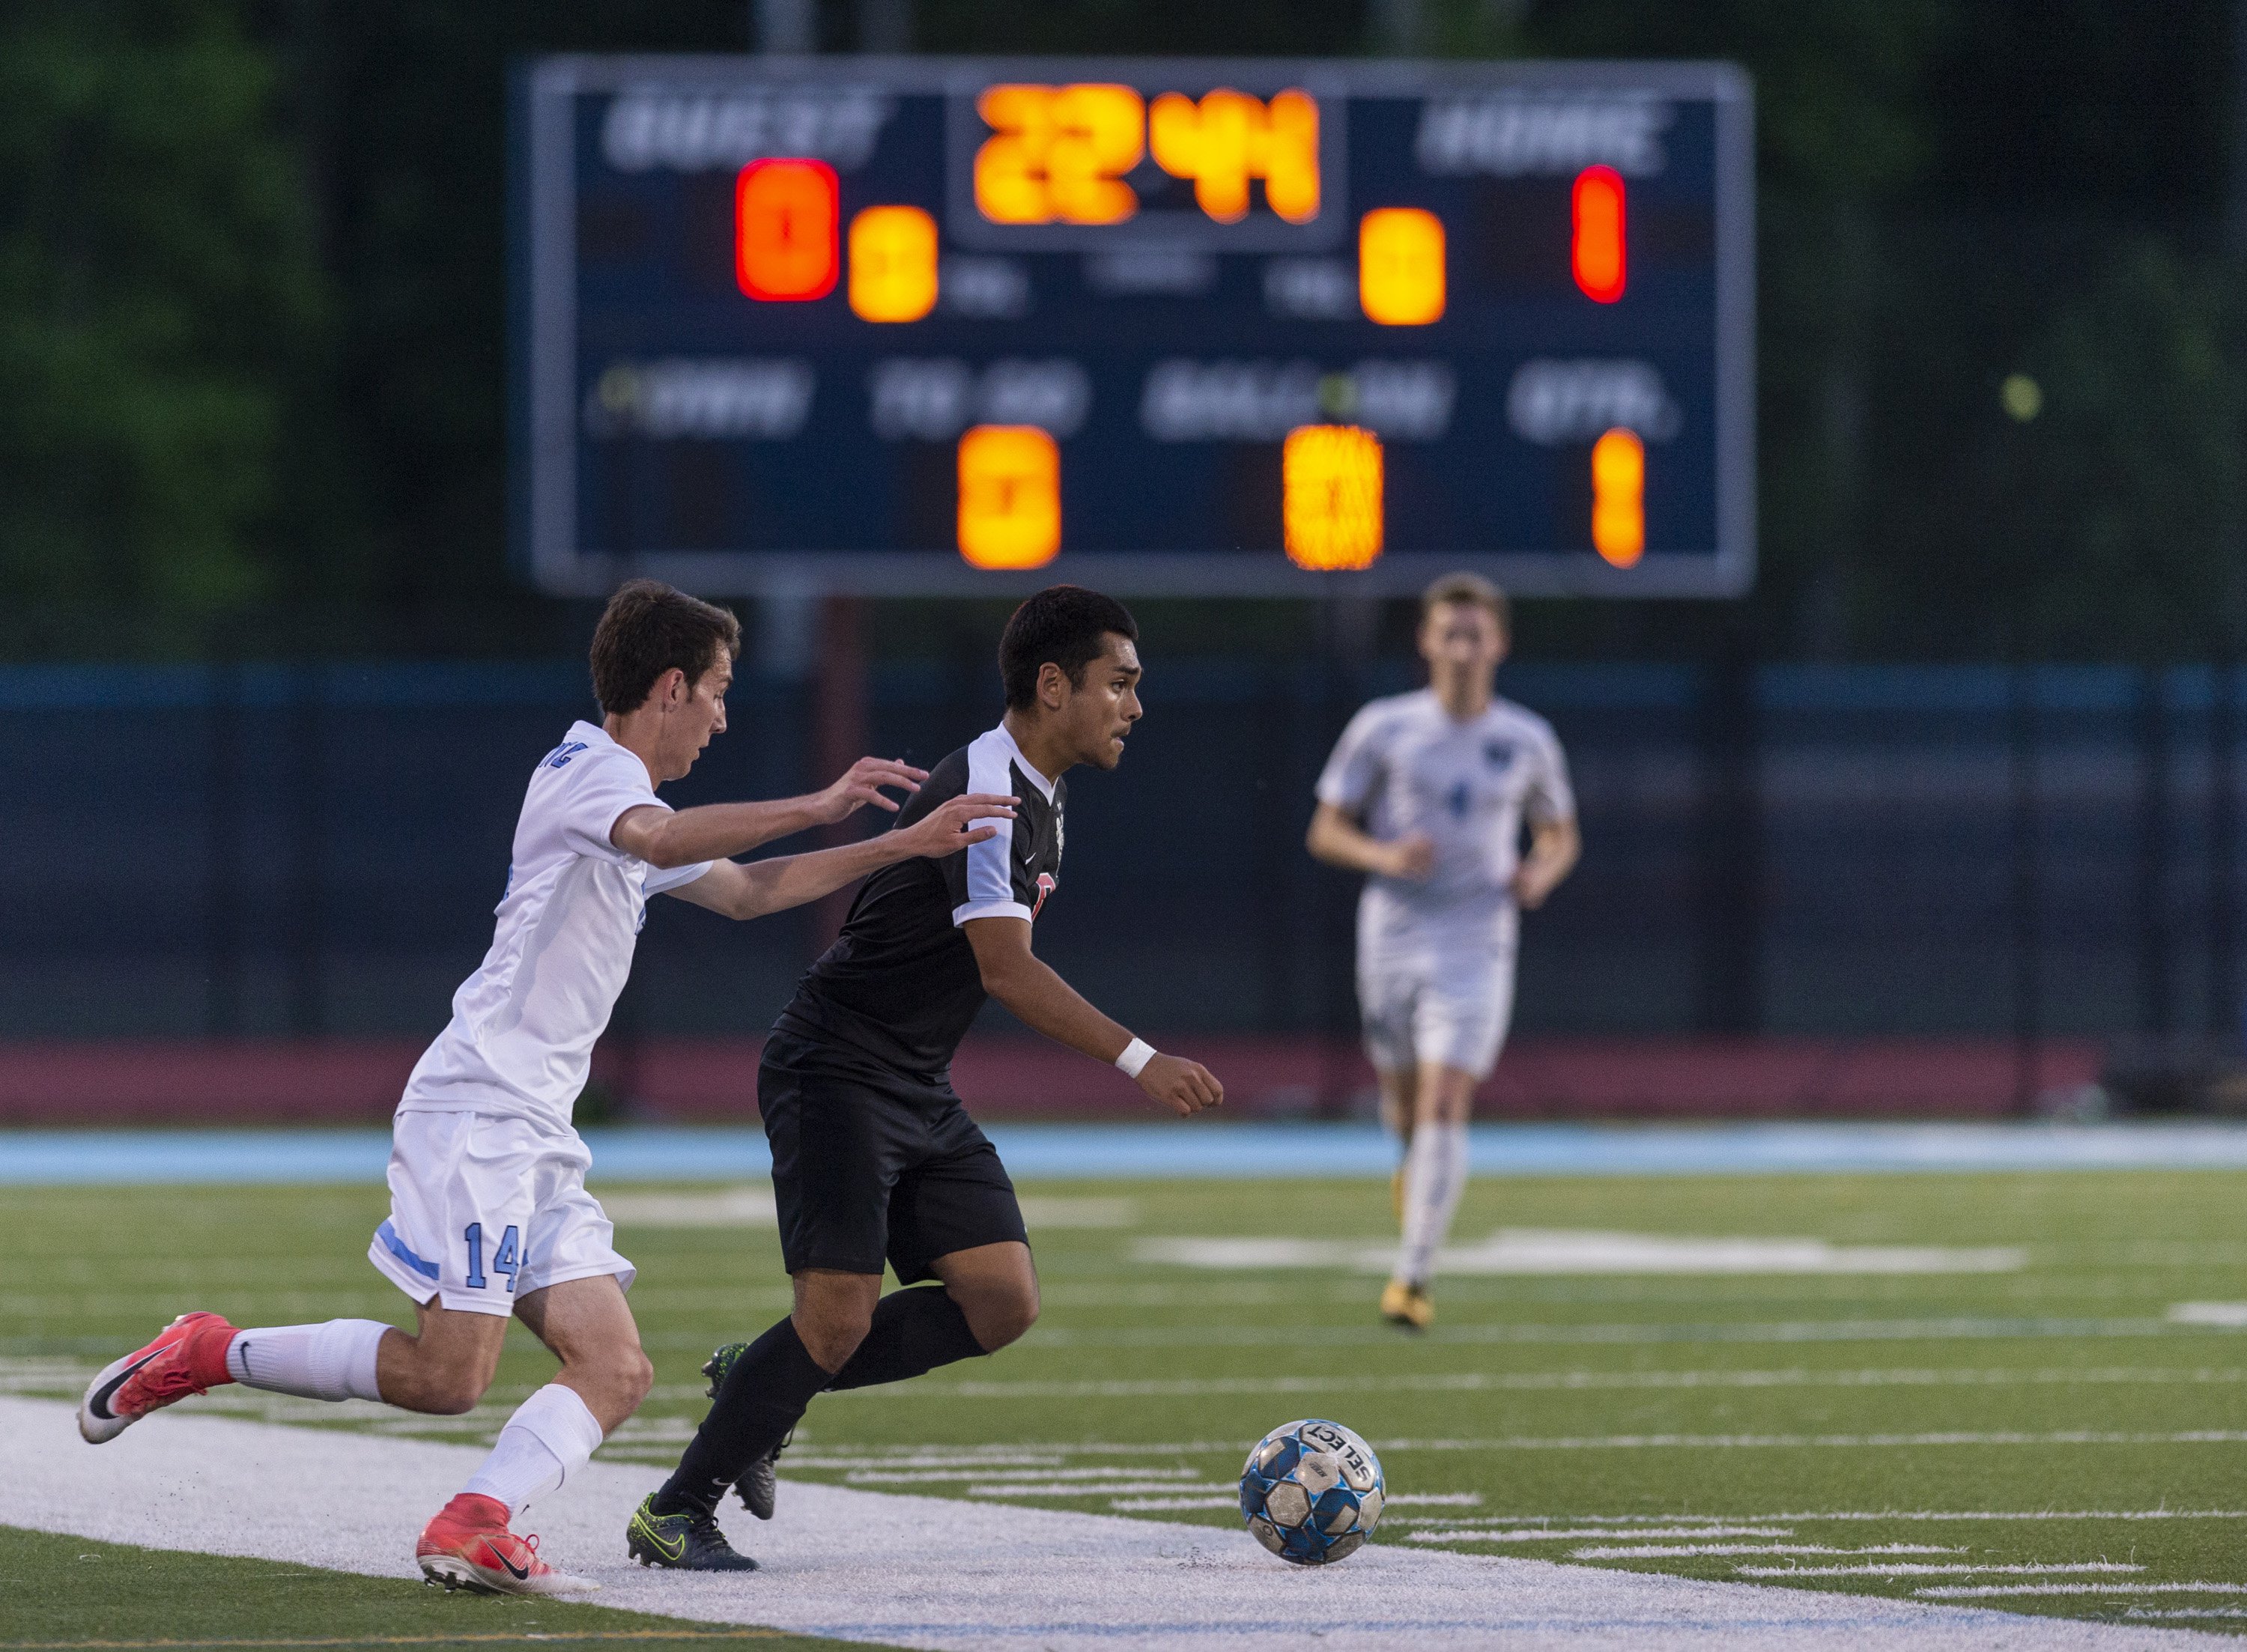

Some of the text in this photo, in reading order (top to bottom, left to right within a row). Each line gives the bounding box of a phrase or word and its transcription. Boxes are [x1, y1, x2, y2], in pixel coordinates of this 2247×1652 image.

[1571, 165, 1627, 304] 1
[1592, 428, 1645, 568] 1
[465, 1222, 518, 1293] 14
[1307, 1426, 1371, 1482] SELECT
